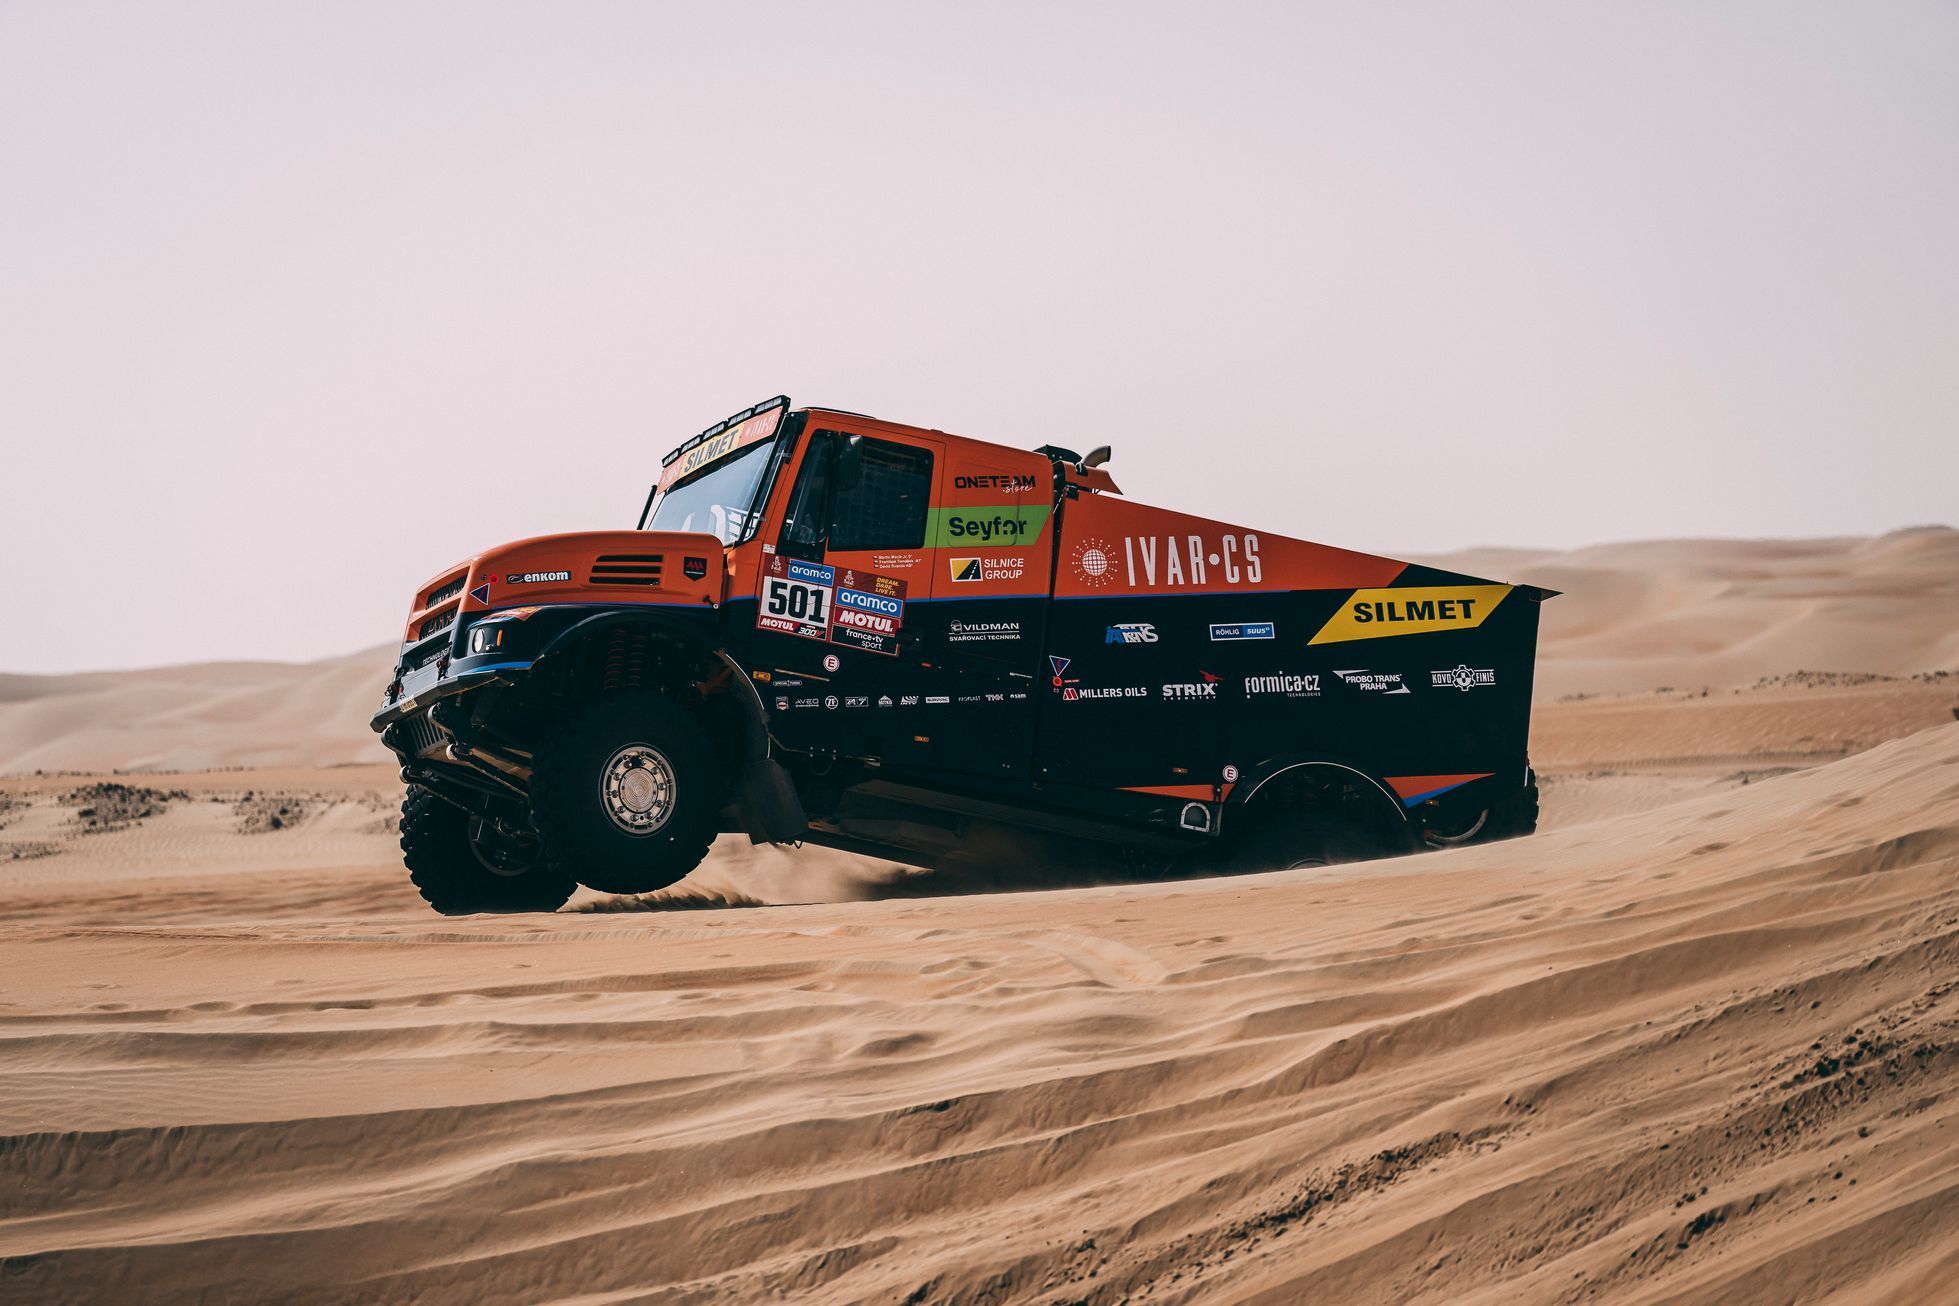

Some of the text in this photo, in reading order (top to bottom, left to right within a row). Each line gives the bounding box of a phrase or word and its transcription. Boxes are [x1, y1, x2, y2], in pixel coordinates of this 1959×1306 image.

[684, 429, 739, 473] SILMET
[954, 475, 1036, 489] ONETEAM
[949, 516, 1028, 541] Seyfor
[983, 558, 1024, 568] SILNICE
[524, 571, 569, 583] enkom
[791, 565, 832, 580] aramco
[985, 570, 1023, 580] GROUP
[876, 577, 900, 587] DREAM.
[768, 580, 826, 624] 501
[841, 592, 898, 613] aramco
[1353, 599, 1477, 623] SILMET
[761, 618, 795, 631] MOTUL
[839, 610, 894, 632] MOTUL
[963, 622, 1020, 631] VILDMAN
[861, 640, 883, 650] sport
[1345, 674, 1401, 684] PROBO TRANS
[1431, 673, 1452, 684] KOVO
[1080, 687, 1148, 698] MILLERS OILS
[1162, 683, 1216, 697] STRIX
